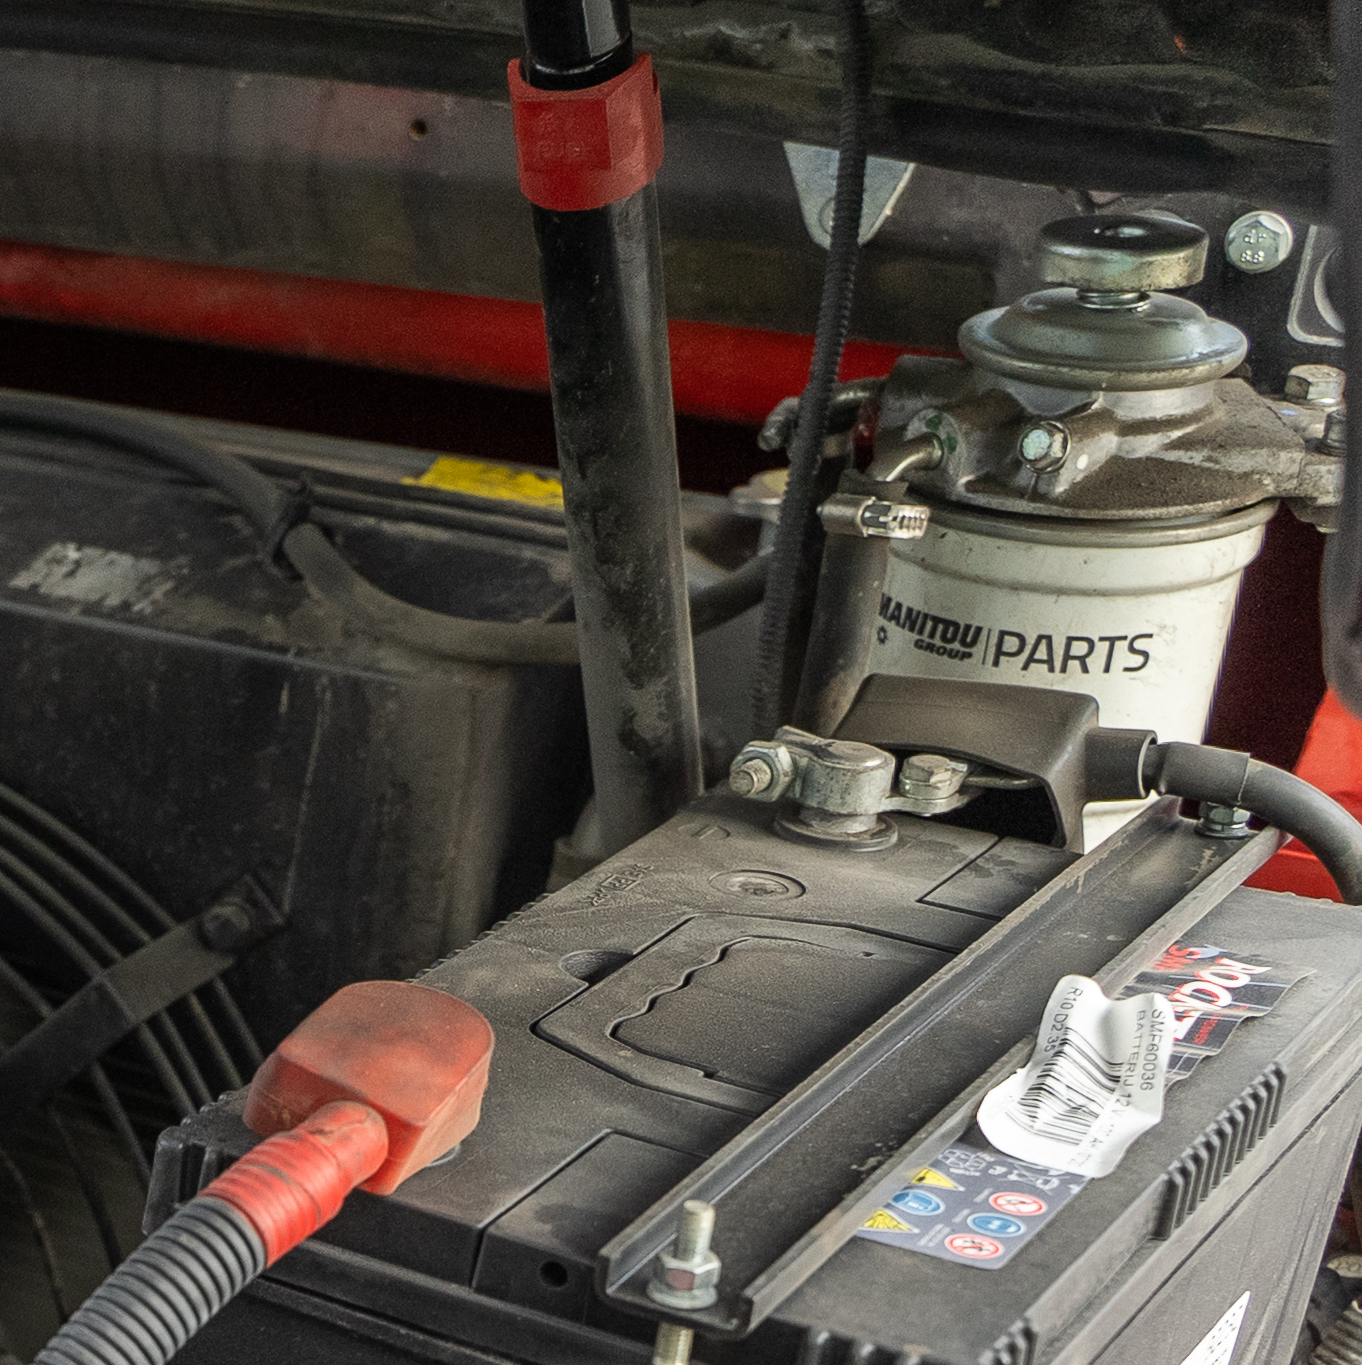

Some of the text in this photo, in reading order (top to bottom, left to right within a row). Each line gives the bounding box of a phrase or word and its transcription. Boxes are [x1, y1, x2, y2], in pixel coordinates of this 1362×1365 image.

[913, 638, 973, 661] GROUP
[991, 630, 1154, 675] PARTS
[1122, 1009, 1147, 1088] BATTERIJ
[1139, 1008, 1167, 1092] SMF60036
